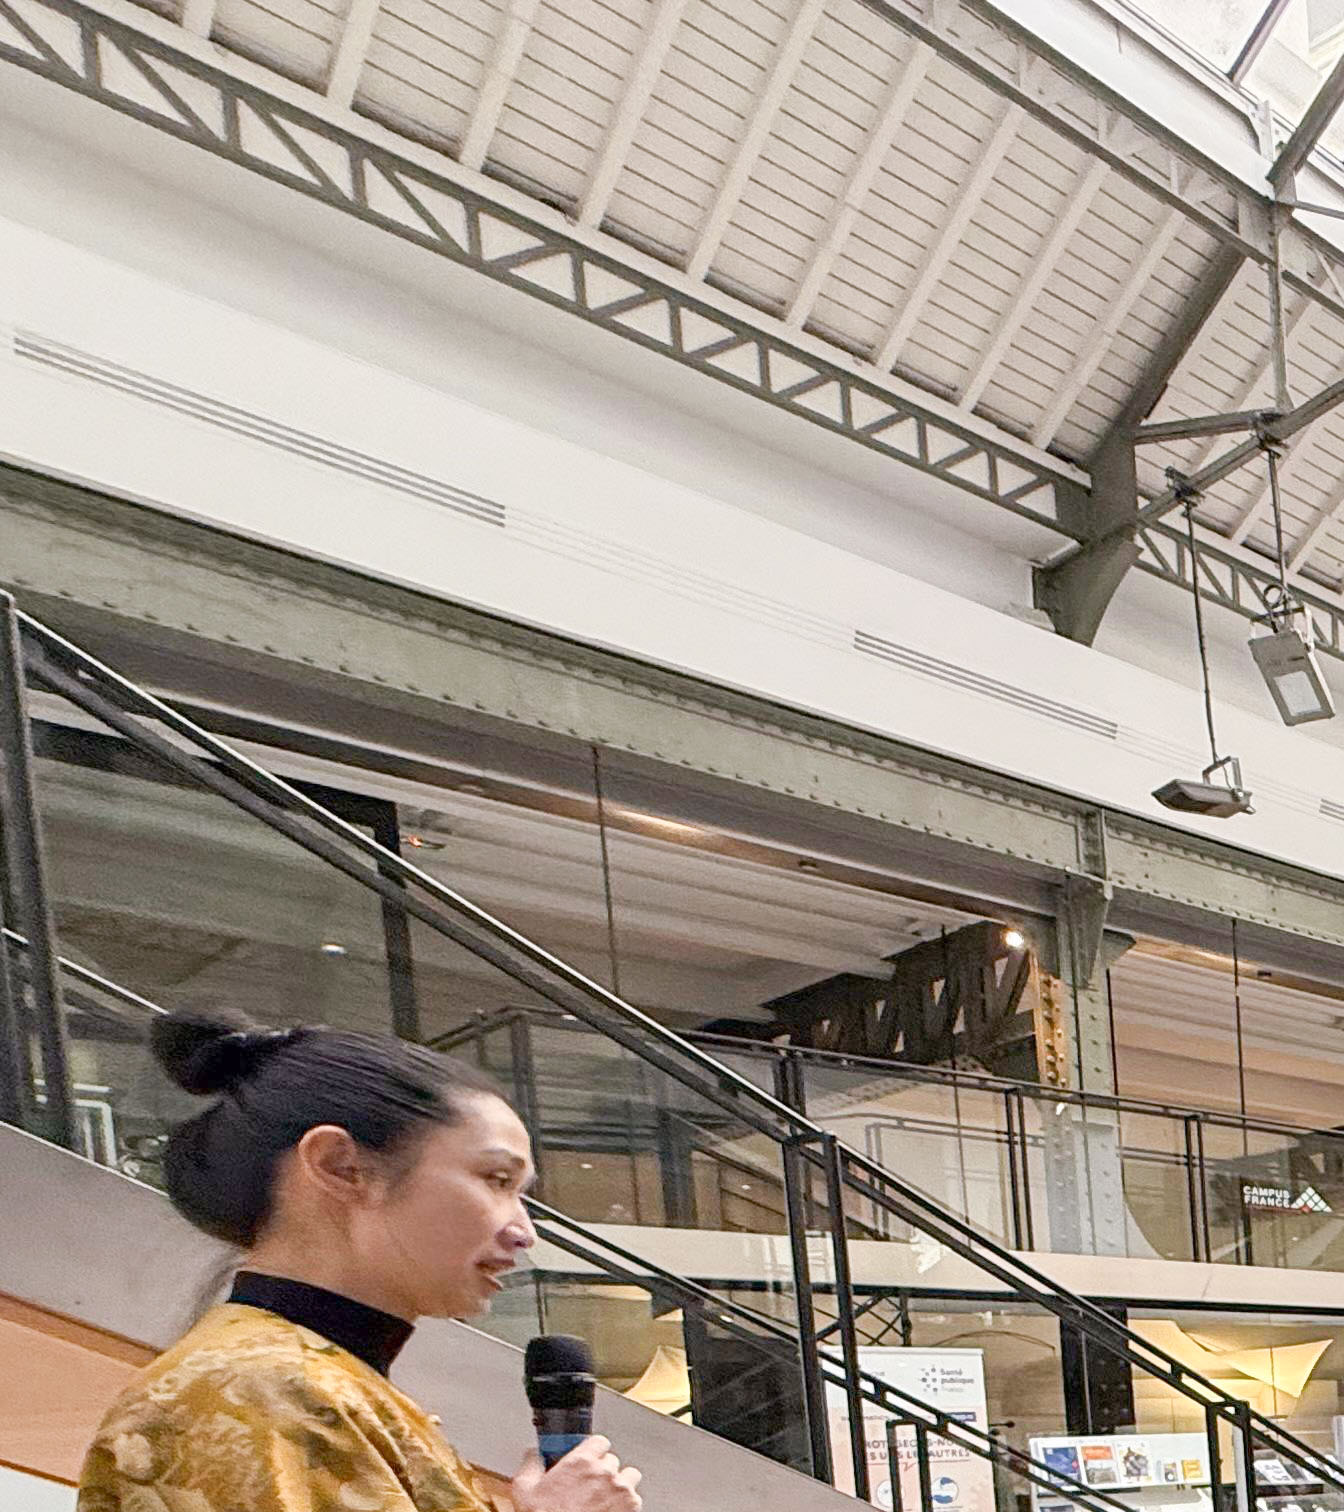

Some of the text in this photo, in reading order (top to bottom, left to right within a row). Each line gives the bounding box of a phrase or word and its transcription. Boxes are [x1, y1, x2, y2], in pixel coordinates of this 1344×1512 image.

[1243, 1186, 1290, 1198] CAMPUS
[1244, 1195, 1290, 1208] FRANCE
[940, 1368, 963, 1376] Santé
[941, 1377, 975, 1385] publique
